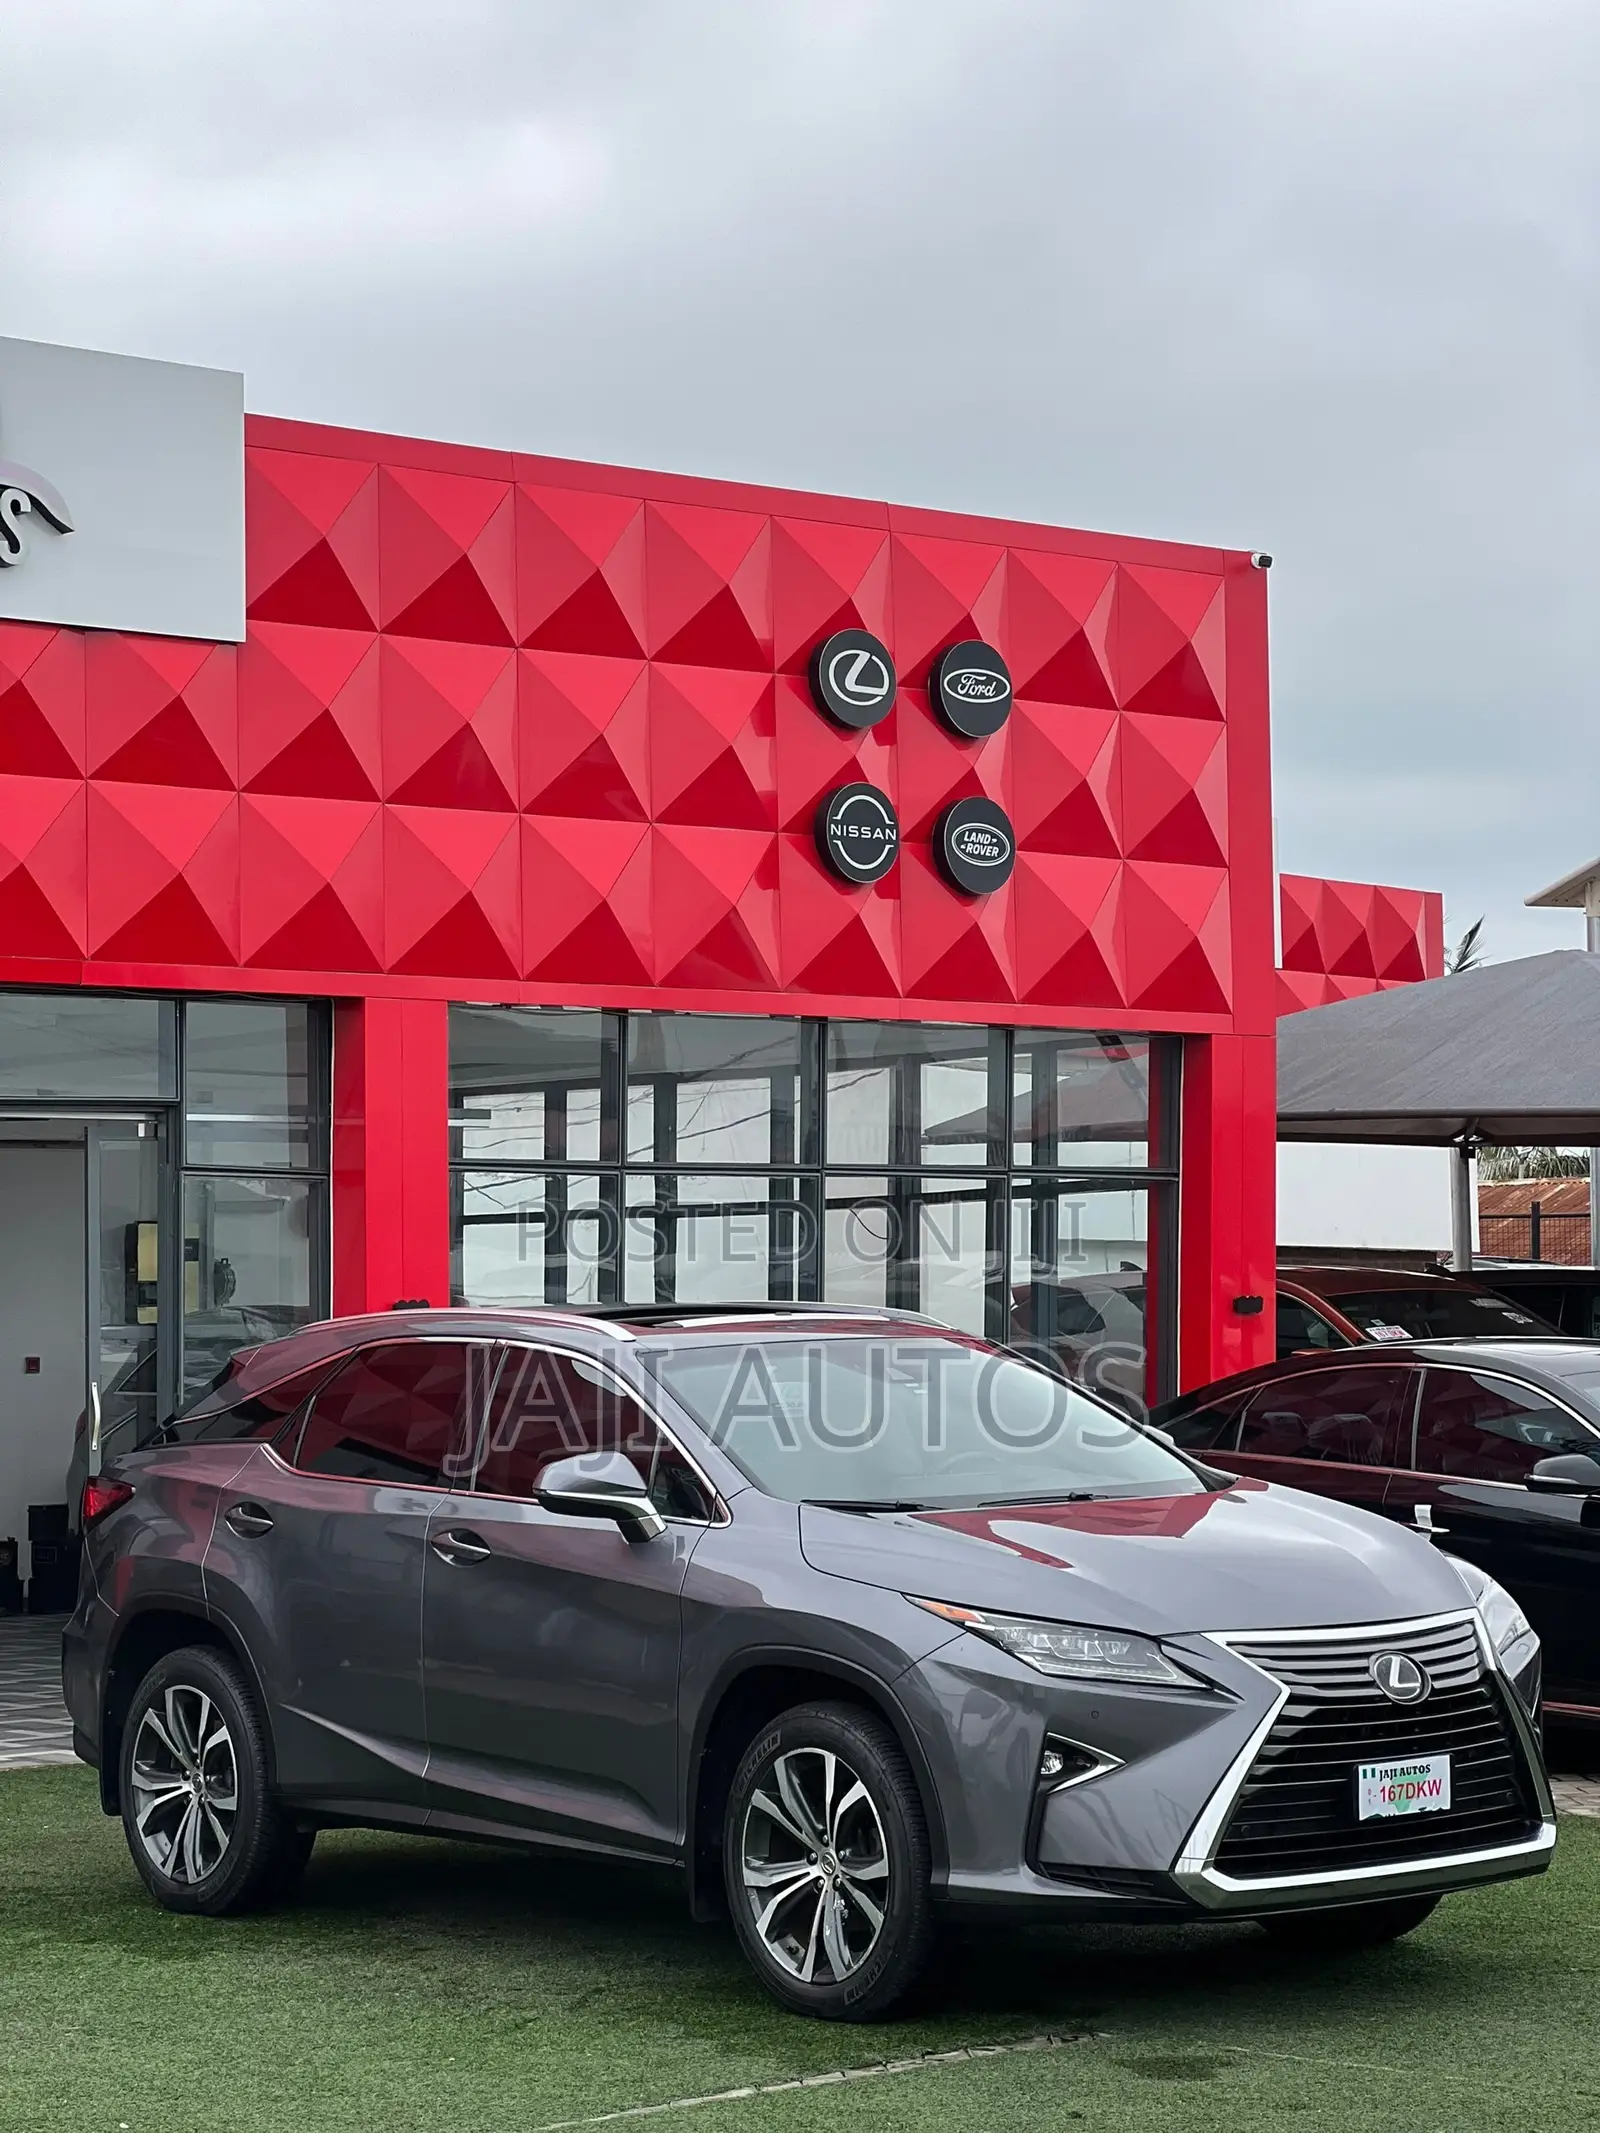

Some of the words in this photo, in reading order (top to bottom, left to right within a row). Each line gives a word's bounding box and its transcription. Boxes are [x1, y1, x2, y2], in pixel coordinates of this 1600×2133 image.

[957, 673, 996, 697] Ford
[830, 823, 897, 841] NISSAN
[963, 831, 991, 844] LAND
[965, 844, 999, 858] ROVER
[1379, 1768, 1397, 1781] JAJI
[1399, 1764, 1431, 1777] AUTOS
